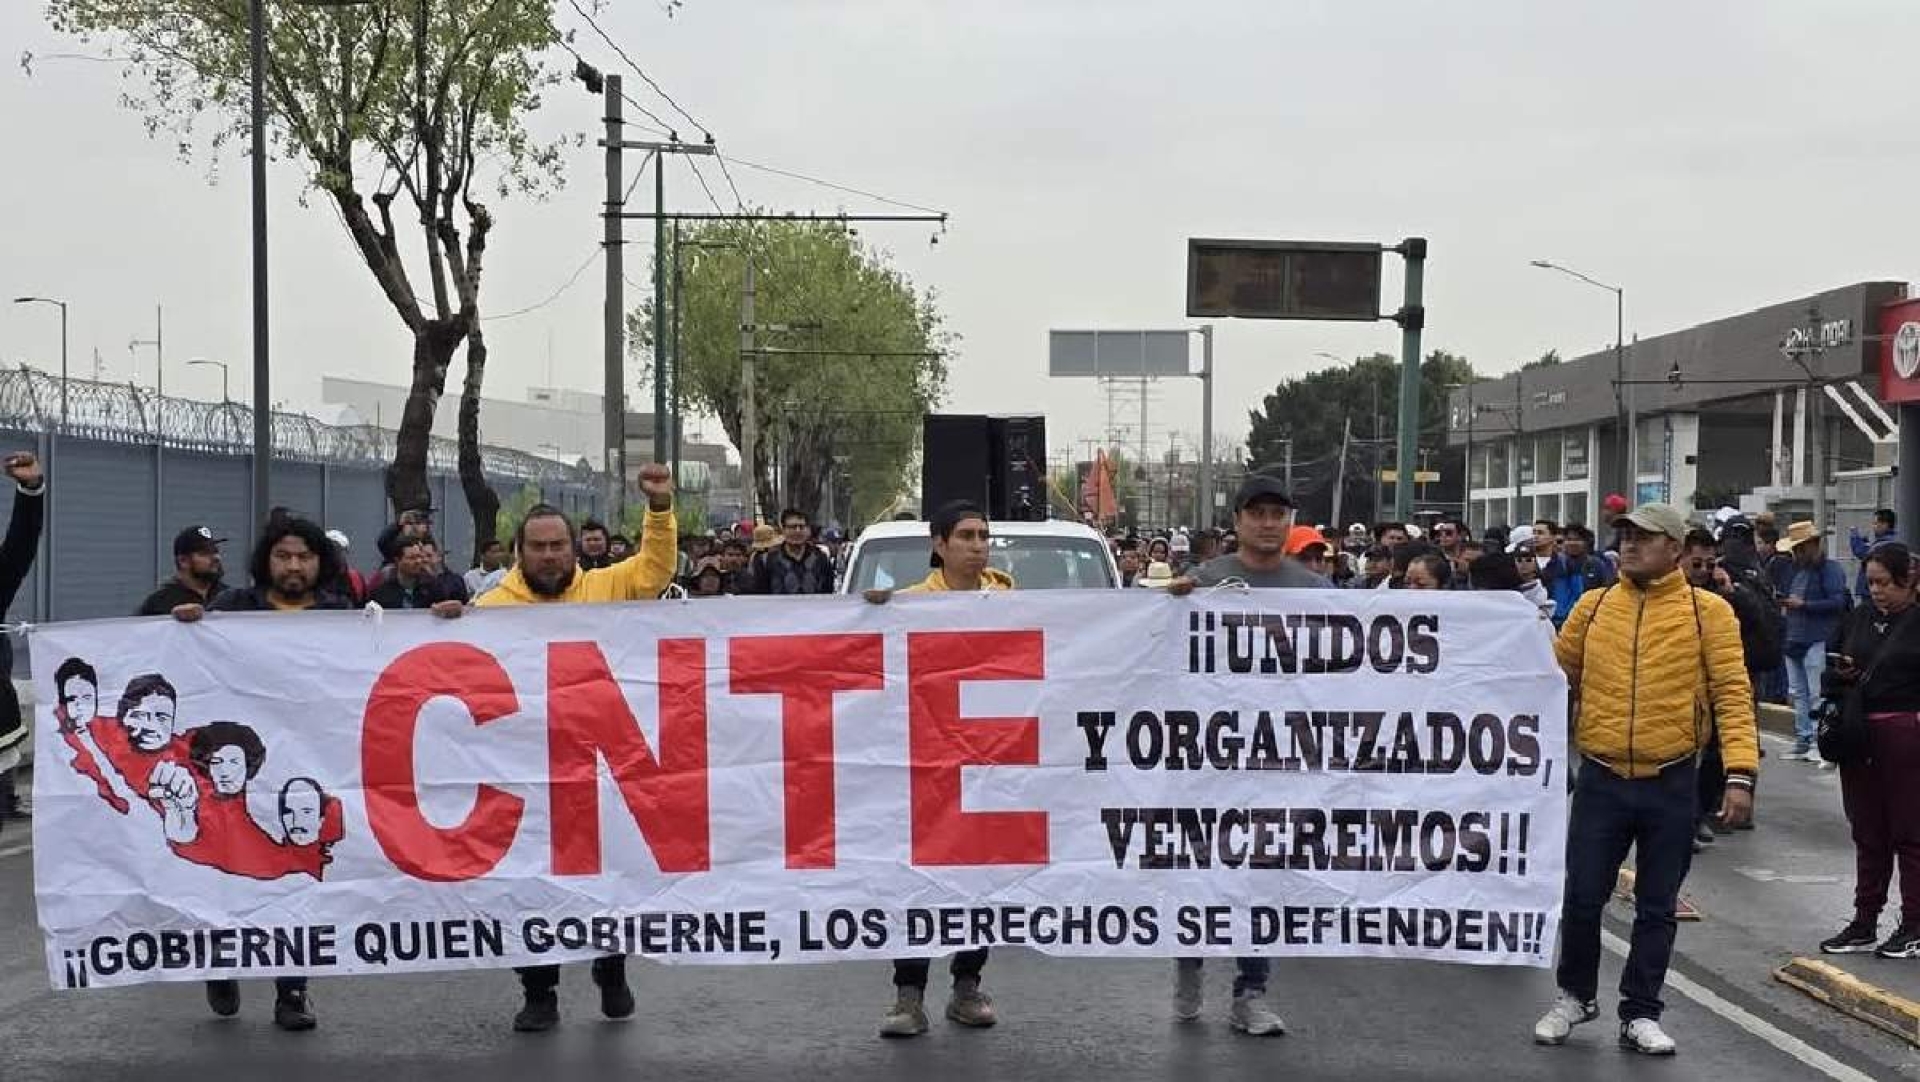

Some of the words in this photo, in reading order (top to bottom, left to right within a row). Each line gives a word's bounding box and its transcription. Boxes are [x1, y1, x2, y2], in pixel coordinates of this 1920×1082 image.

[1190, 611, 1439, 675] ¡¡UNIDOS
[361, 629, 1050, 882] CNTE
[1077, 711, 1116, 771] Y
[1126, 710, 1553, 788] ORGANIZADOS,
[1101, 807, 1530, 876] VENCEREMOS!!
[64, 924, 337, 988] ¡¡GOBIERNE
[354, 919, 503, 965] QUIEN
[522, 911, 780, 960] GOBIERNE,
[800, 908, 887, 951] LOS
[907, 905, 1159, 947] DERECHOS
[1176, 905, 1233, 946] SE
[1250, 905, 1546, 954] DEFIENDEN!!
